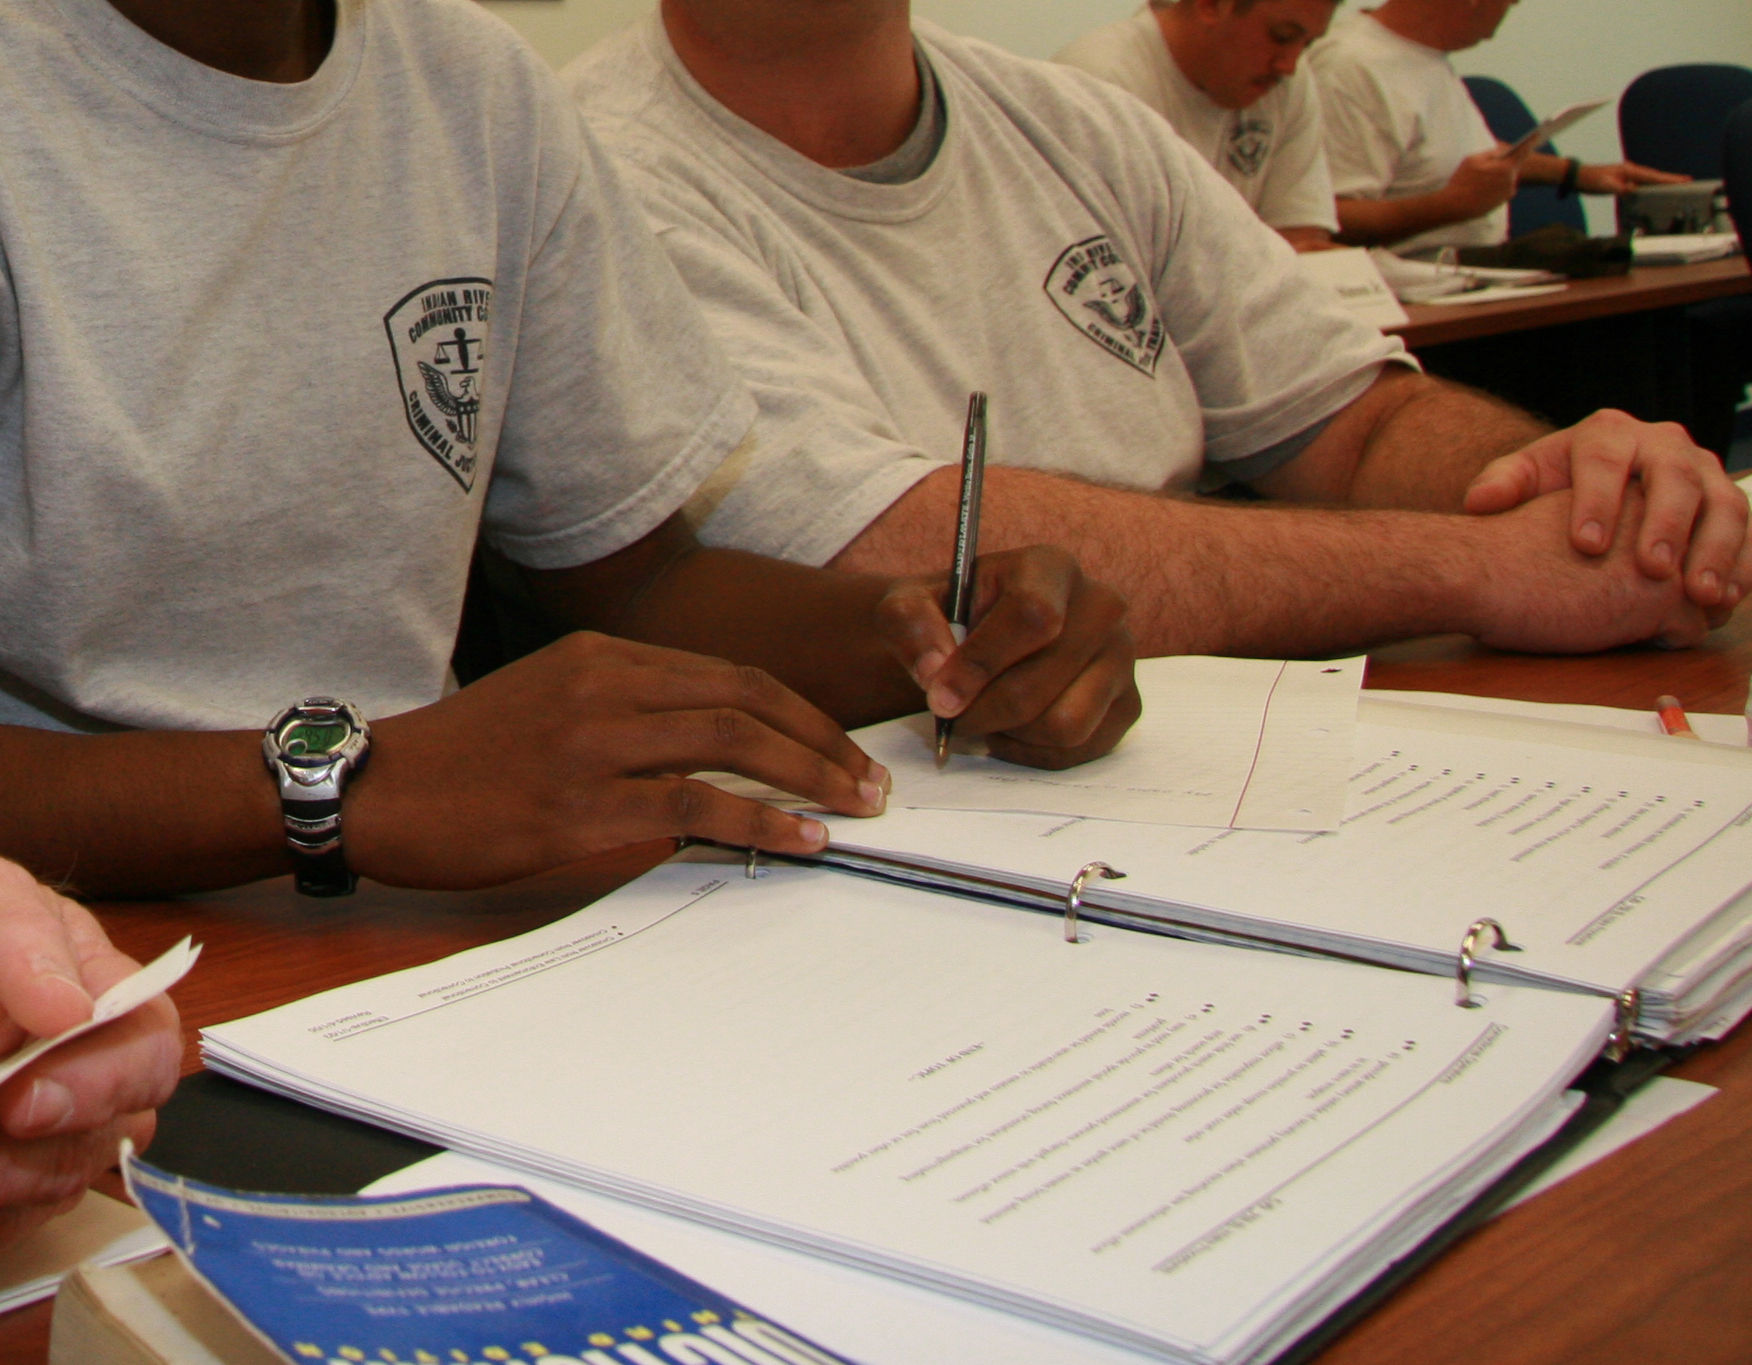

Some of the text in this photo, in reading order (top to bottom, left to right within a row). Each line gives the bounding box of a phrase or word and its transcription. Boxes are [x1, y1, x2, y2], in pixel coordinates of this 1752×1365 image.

[463, 289, 491, 307] RIVE
[409, 306, 472, 344] COMMUNITY
[409, 390, 454, 460] CRIMINAL
